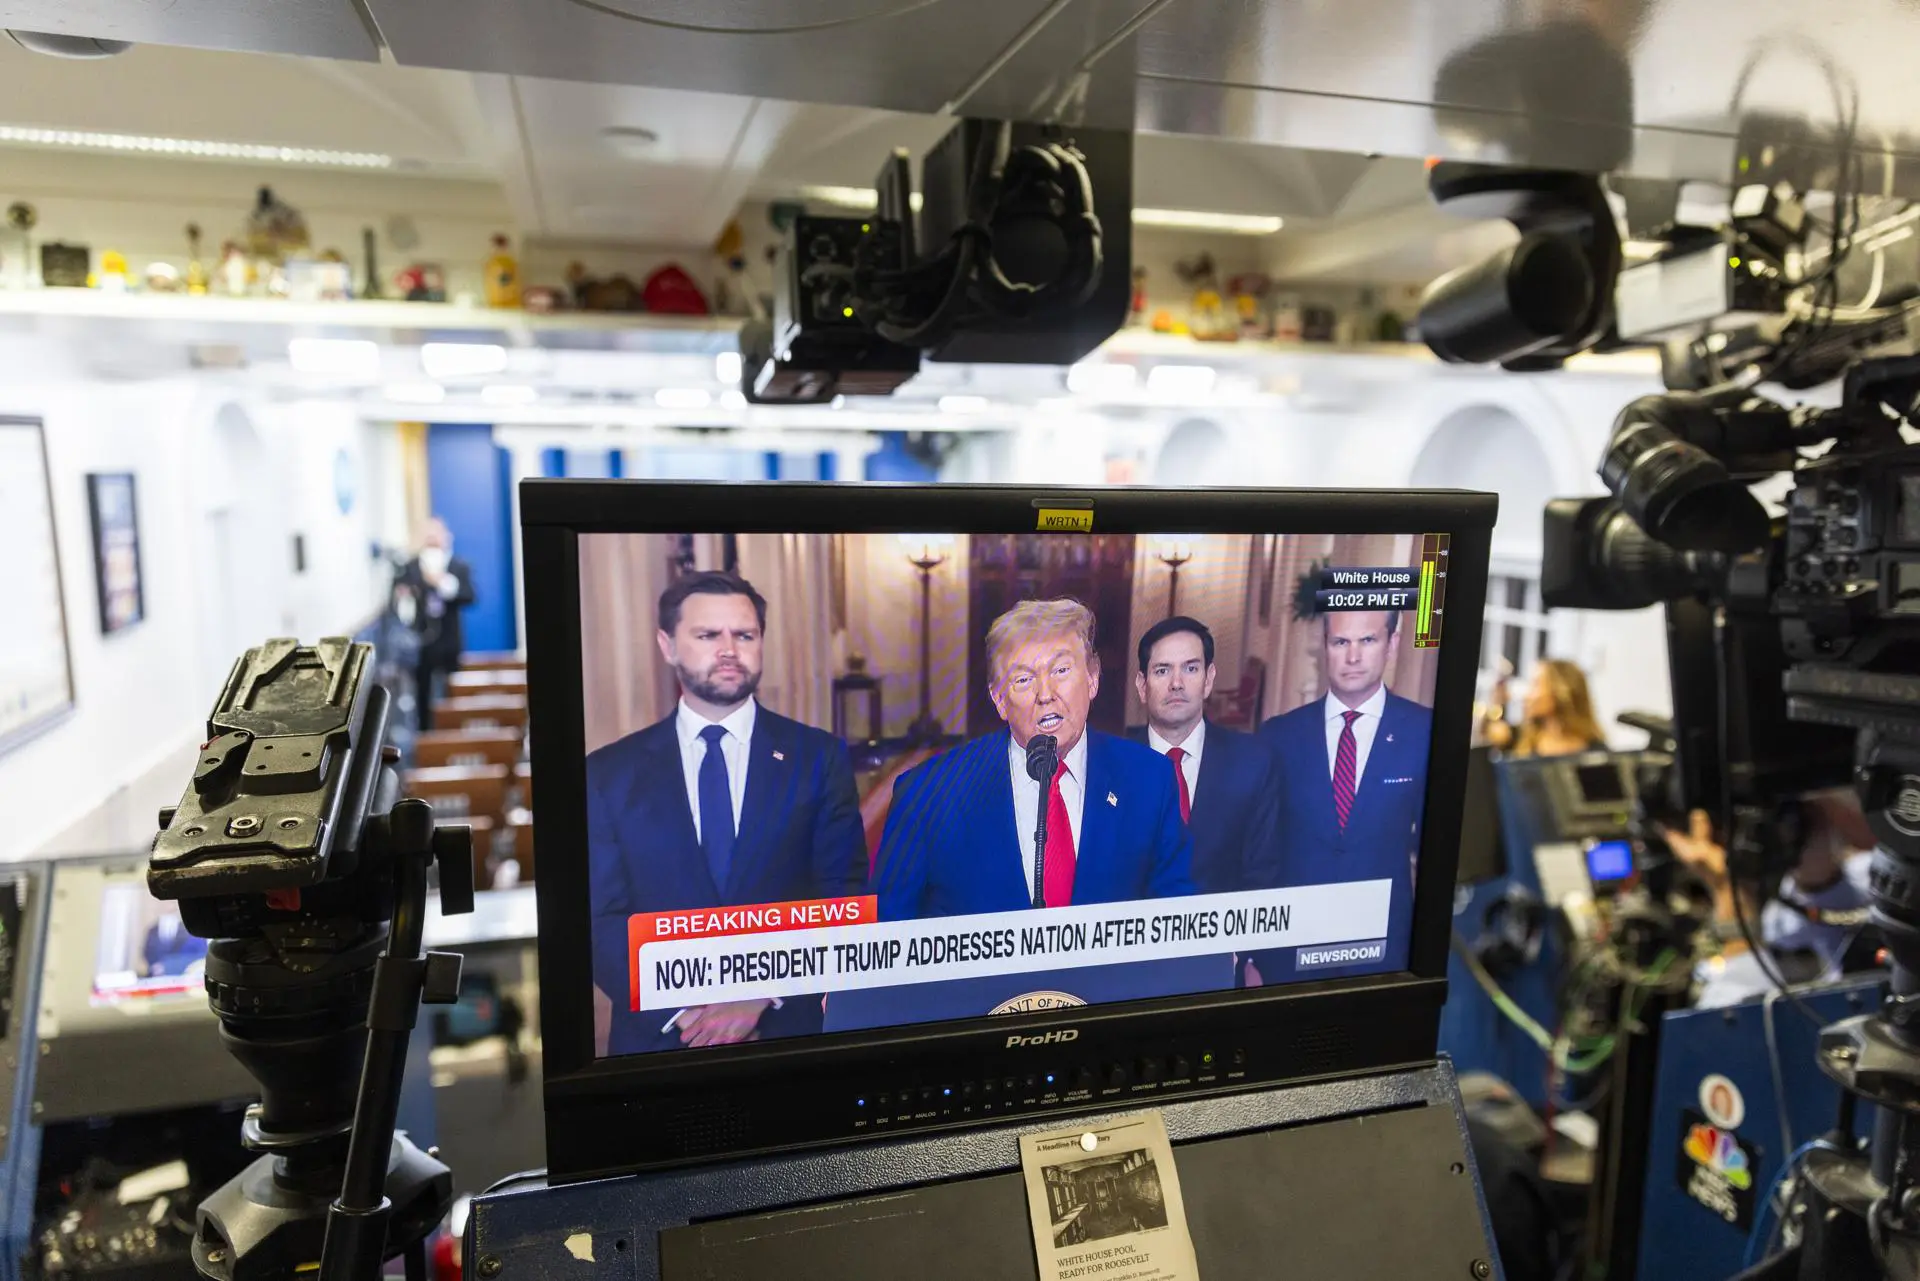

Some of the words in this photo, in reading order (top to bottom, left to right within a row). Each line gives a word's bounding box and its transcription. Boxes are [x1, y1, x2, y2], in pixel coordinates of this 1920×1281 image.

[1045, 516, 1080, 527] WRTN
[1083, 517, 1088, 527] 1
[1333, 572, 1369, 584] White
[1372, 571, 1410, 584] House
[1327, 594, 1364, 607] 10:02
[1367, 594, 1387, 606] PM
[1391, 593, 1408, 606] ET
[655, 908, 782, 936] BREAKING
[790, 901, 860, 925] NEWS
[655, 957, 713, 991] NOW:
[719, 946, 828, 985] PRESIDENT
[834, 939, 901, 974] TRUMP
[906, 928, 1015, 967] ADDRESSES
[1020, 923, 1086, 956] NATION
[1091, 917, 1146, 949] AFTER
[1150, 910, 1218, 944] STRIKES
[1223, 908, 1248, 936] ON
[1252, 904, 1291, 934] IRAN
[1300, 945, 1381, 966] NEWSROOM
[1038, 998, 1053, 1008] OF
[1005, 1029, 1079, 1048] ProHD
[914, 1111, 937, 1119] ANALOG
[1042, 1141, 1069, 1151] Headline
[1057, 1256, 1084, 1267] WHITE
[1085, 1249, 1113, 1263] HOUSE
[1114, 1244, 1136, 1257] POOL
[1059, 1267, 1085, 1280] READY
[1087, 1263, 1103, 1274] FOR
[1105, 1253, 1150, 1269] ROOSEVELT
